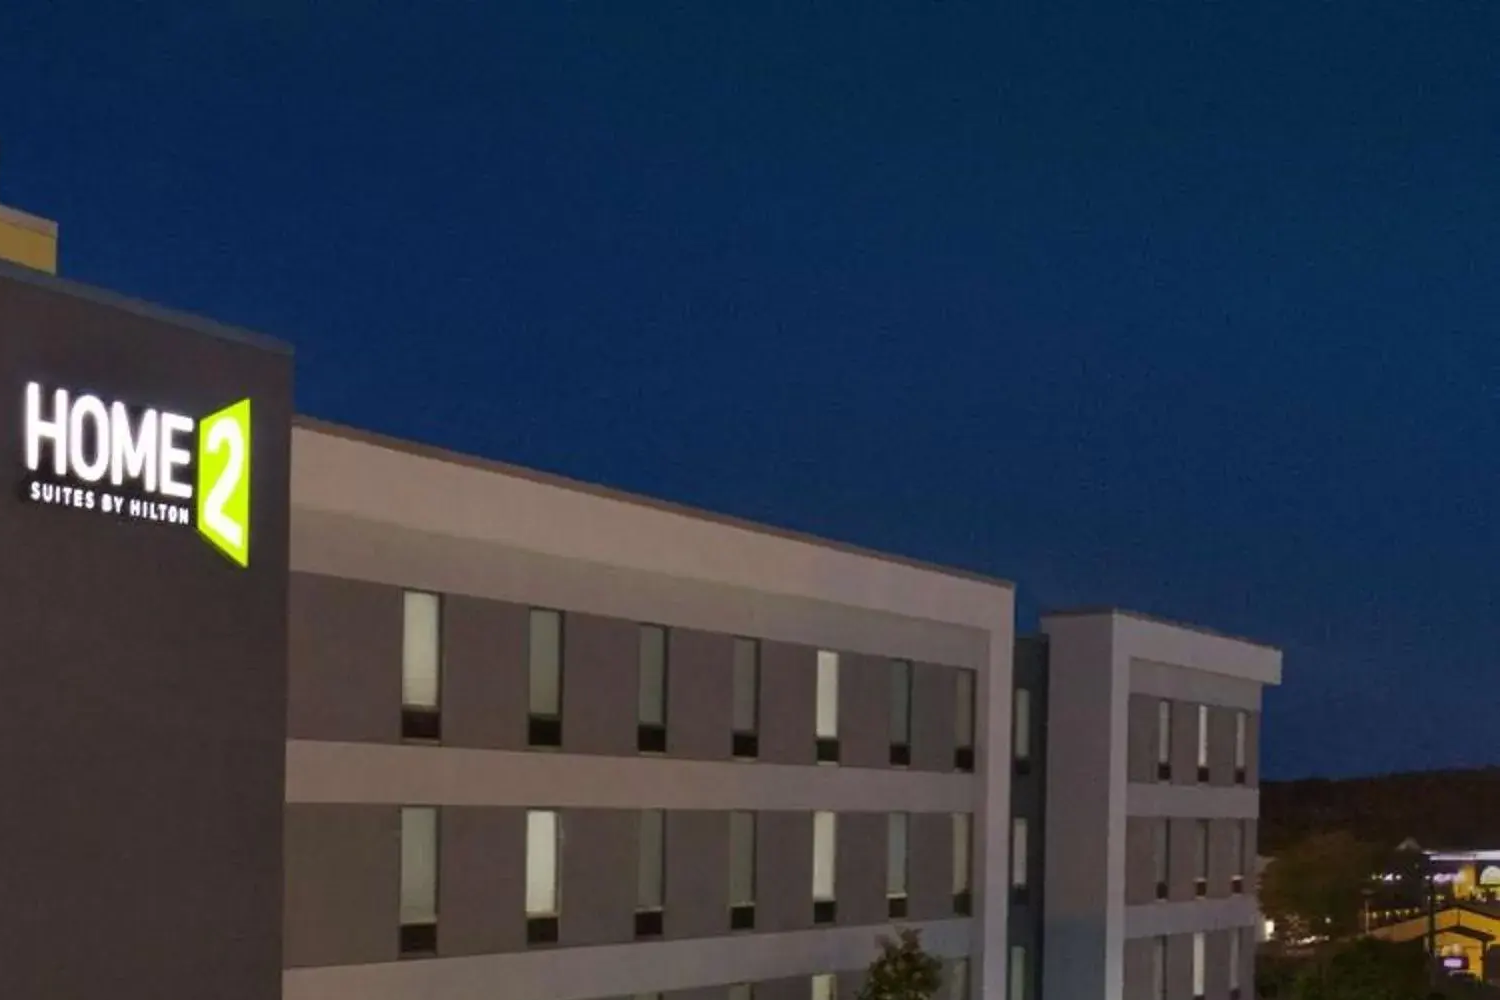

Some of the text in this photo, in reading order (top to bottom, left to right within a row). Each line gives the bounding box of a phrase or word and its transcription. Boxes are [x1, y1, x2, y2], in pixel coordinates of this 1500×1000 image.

[26, 381, 194, 499] HOME
[30, 481, 189, 525] SUITES BY HILTON
